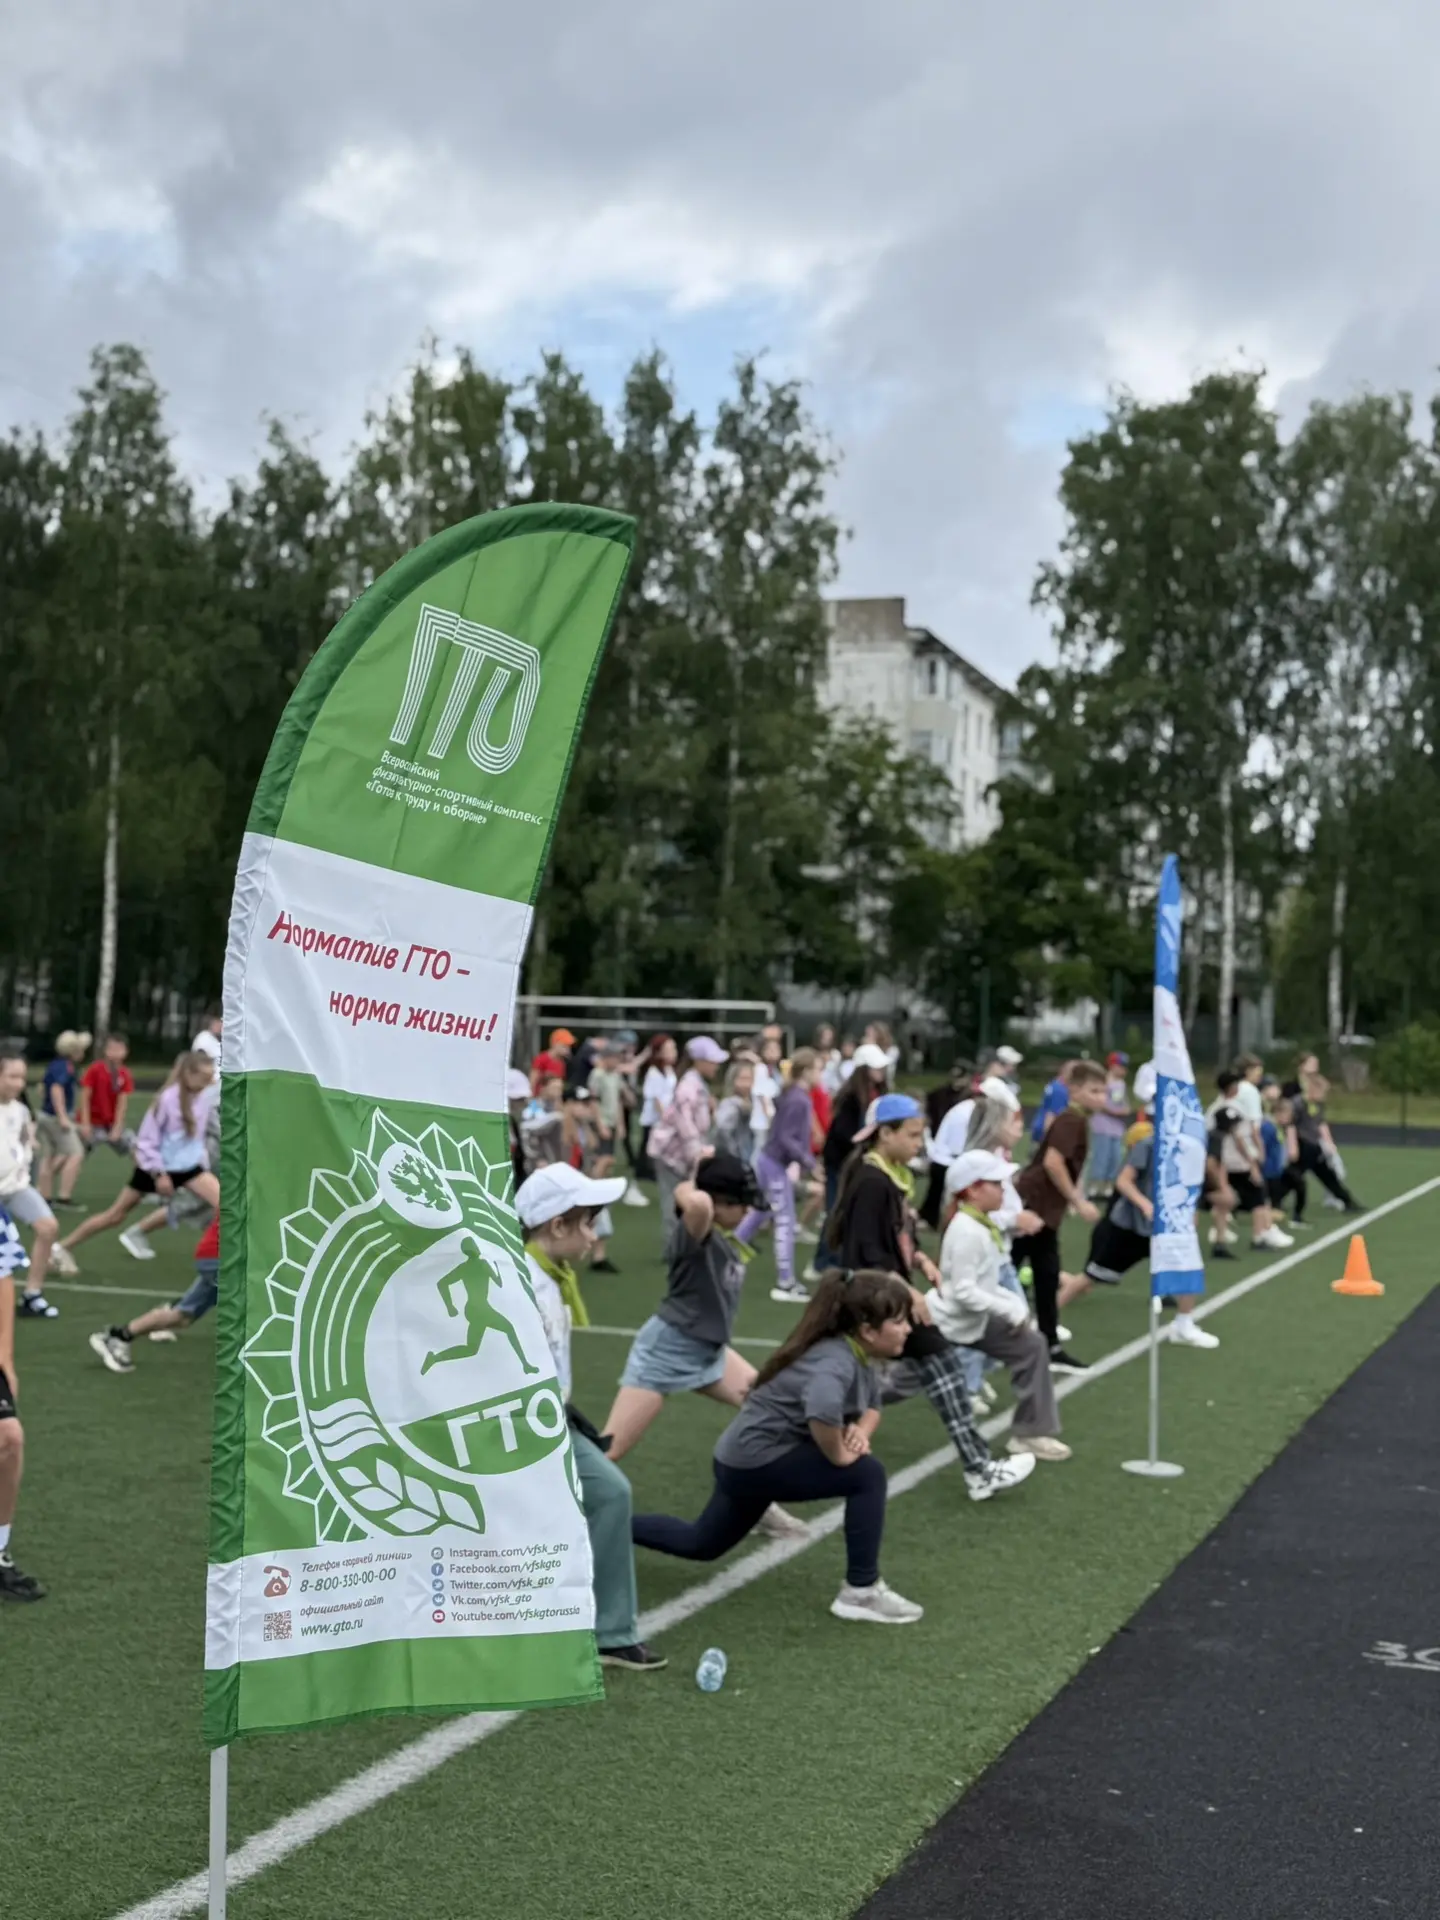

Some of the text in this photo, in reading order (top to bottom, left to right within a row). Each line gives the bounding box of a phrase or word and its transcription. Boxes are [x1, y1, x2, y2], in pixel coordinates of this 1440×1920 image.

[389, 603, 541, 775] ГТО
[395, 791, 402, 801] к
[404, 793, 431, 812] труду
[433, 802, 441, 812] и
[443, 804, 487, 824] обороне»
[493, 804, 543, 825] комплекс
[266, 910, 399, 969] Норматив
[402, 944, 451, 980] ГТО
[329, 991, 498, 1041] норма жизни!
[446, 1388, 565, 1468] ГТО
[301, 1560, 340, 1572] Телефон
[375, 1551, 412, 1562] линии»
[449, 1543, 569, 1559] Instagram.com/vfsk_gto
[449, 1559, 561, 1574] Facebook.com/vfskgto
[299, 1567, 397, 1592] 8-800-350-00-00
[450, 1575, 554, 1590] Twitter.com/vfsk_gto
[300, 1595, 384, 1617] официальный сайт
[450, 1593, 532, 1607] Vk.com/vfsk_gto
[451, 1605, 580, 1622] Youtube.com/vfskgtorussia
[301, 1618, 363, 1636] www.gto.ru
